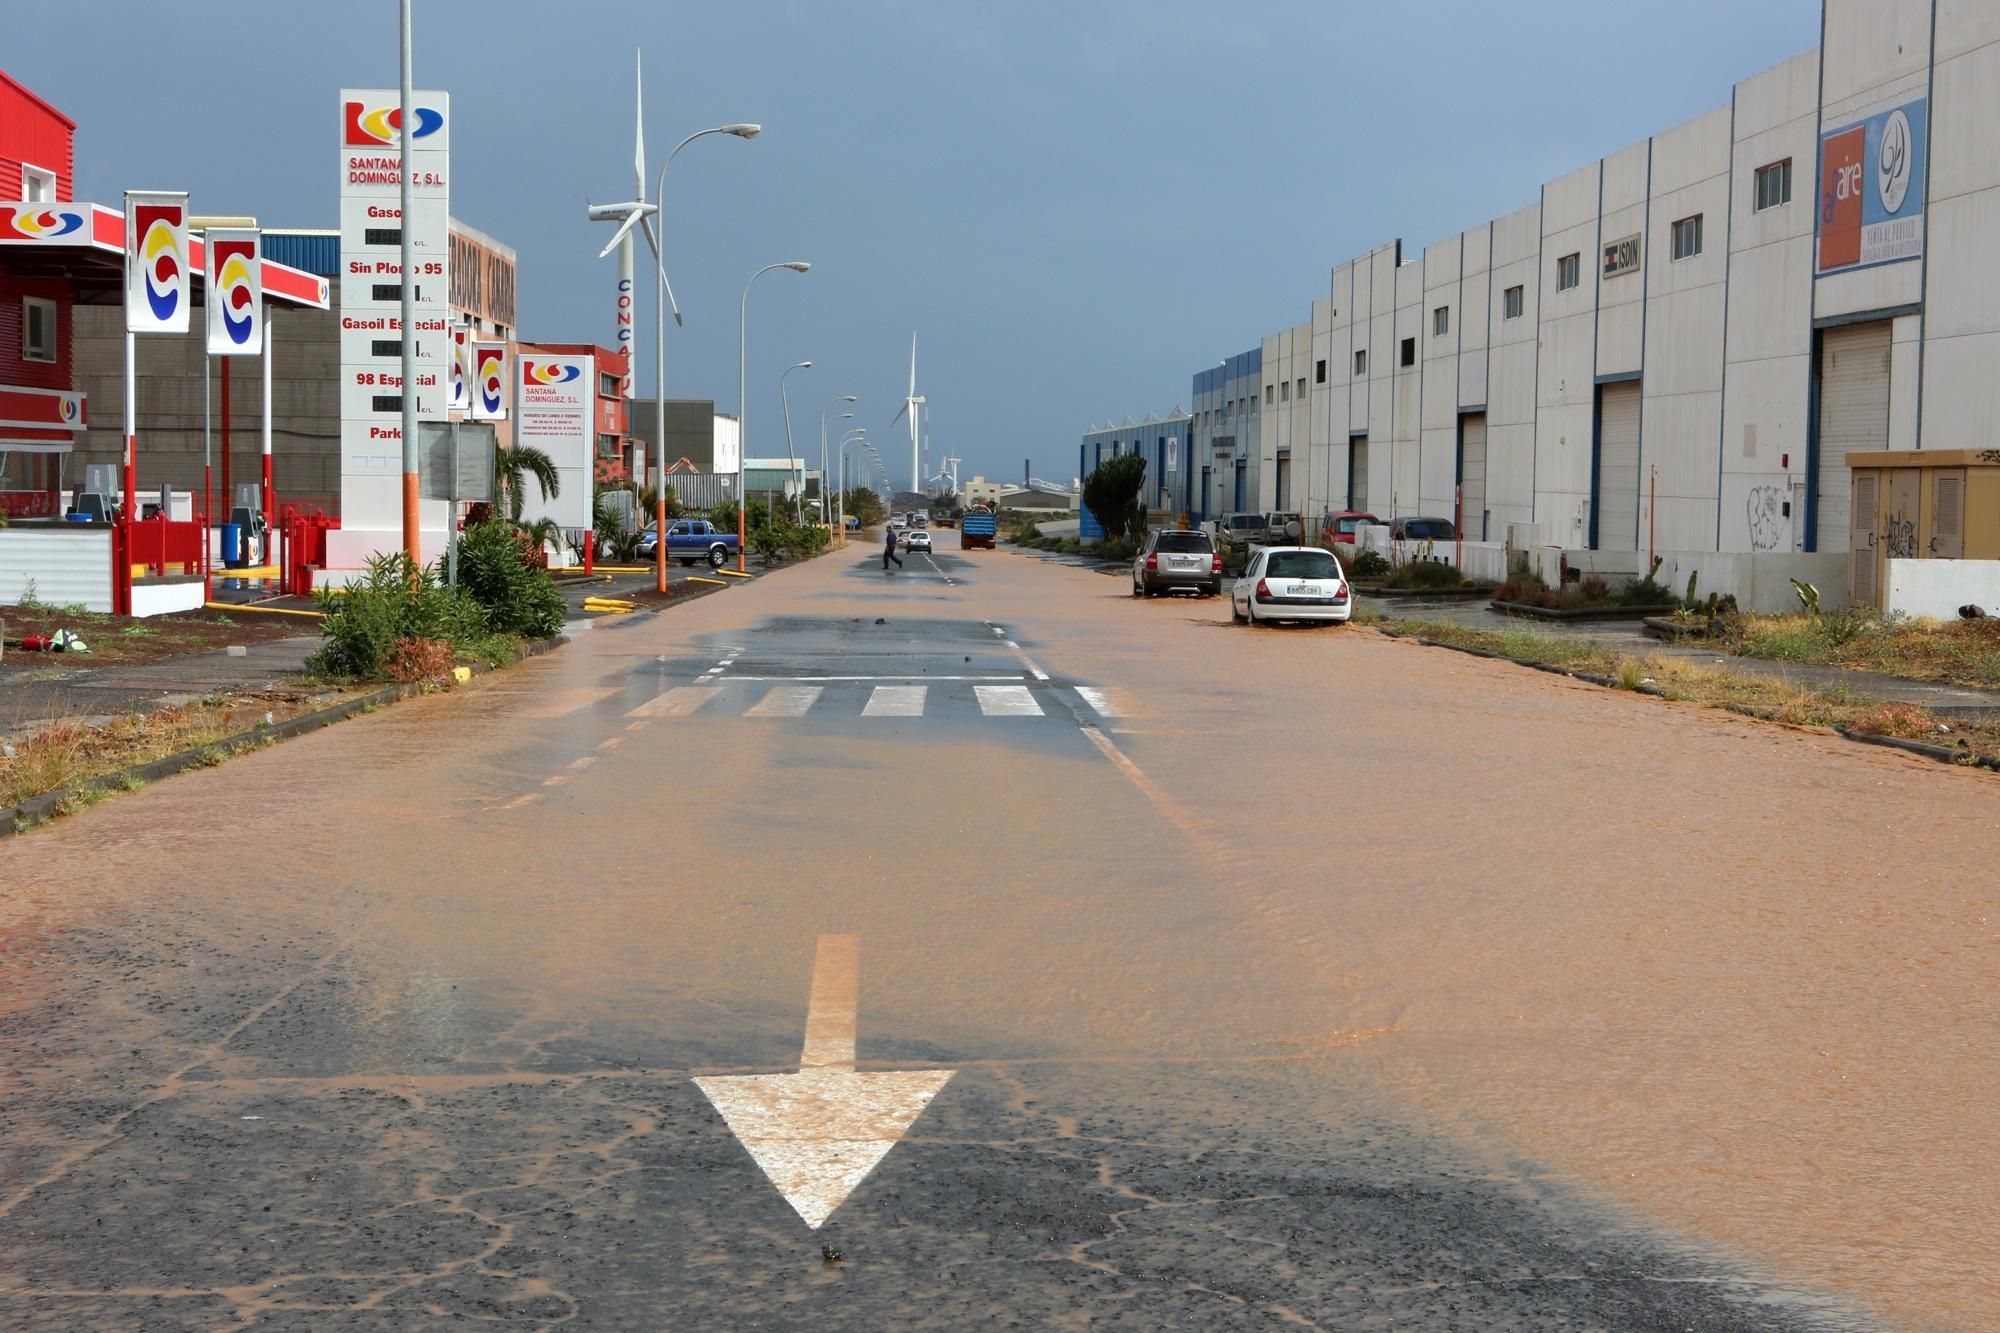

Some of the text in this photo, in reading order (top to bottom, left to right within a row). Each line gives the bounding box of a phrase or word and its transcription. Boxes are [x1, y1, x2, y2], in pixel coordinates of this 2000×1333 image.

[426, 173, 446, 184] S.L.
[350, 262, 371, 273] Sin
[424, 263, 442, 274] 95
[342, 318, 445, 330] Gasoil Esecial
[356, 373, 436, 388] 98 Espial
